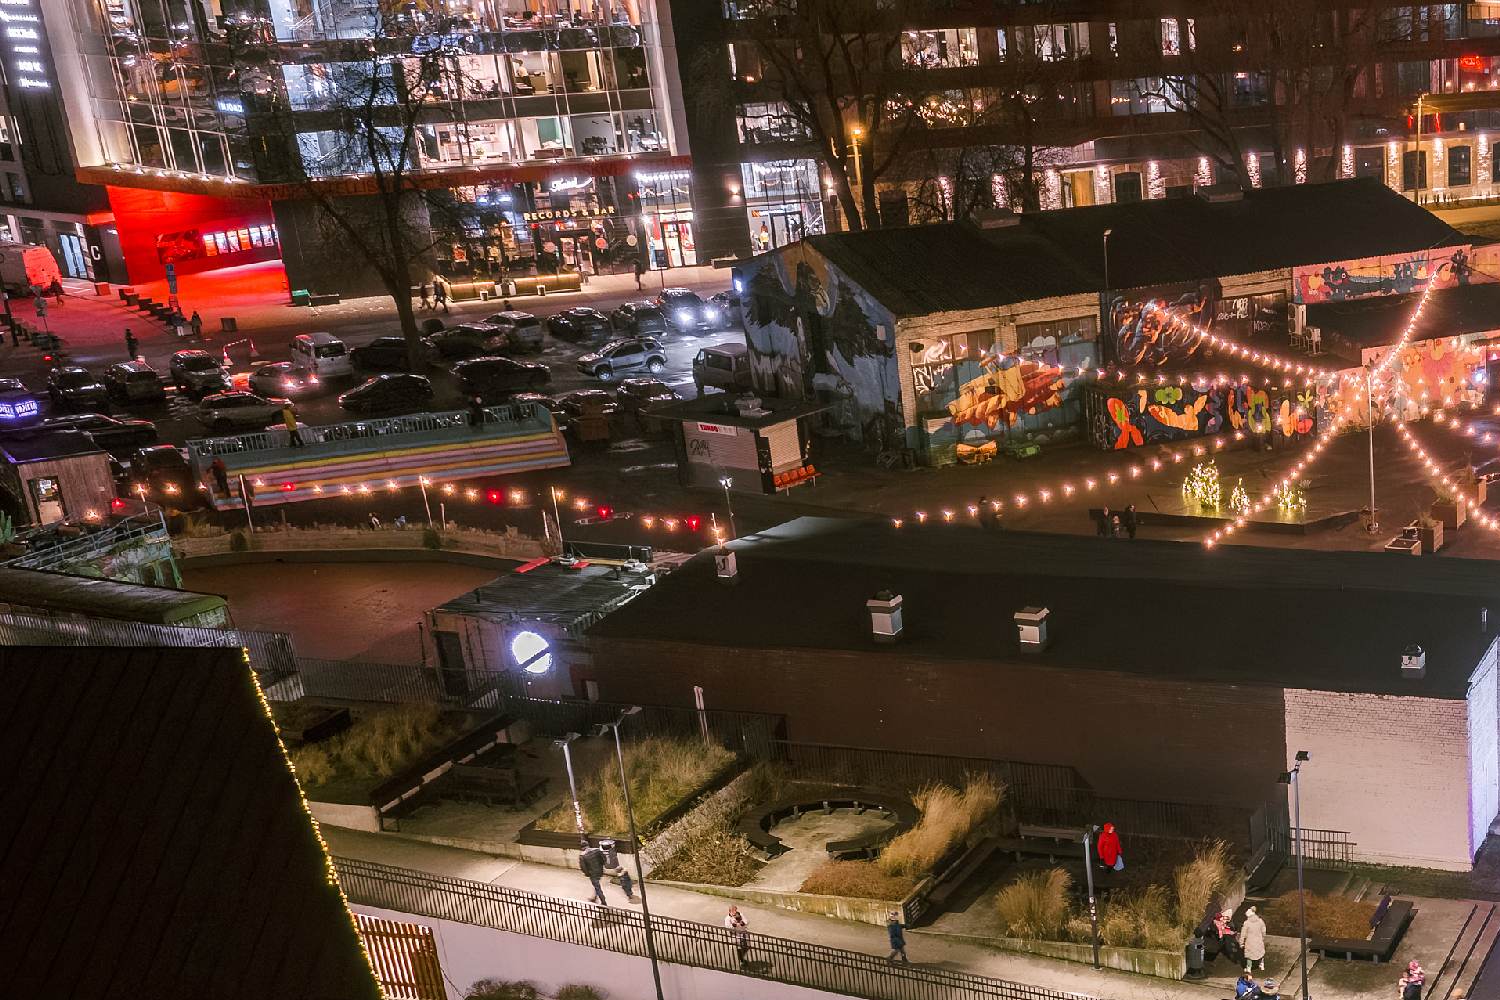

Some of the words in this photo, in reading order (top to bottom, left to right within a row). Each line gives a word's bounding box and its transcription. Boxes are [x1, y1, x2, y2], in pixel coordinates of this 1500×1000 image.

[523, 208, 578, 221] RECORDS
[593, 205, 616, 216] BAR
[90, 245, 101, 261] C
